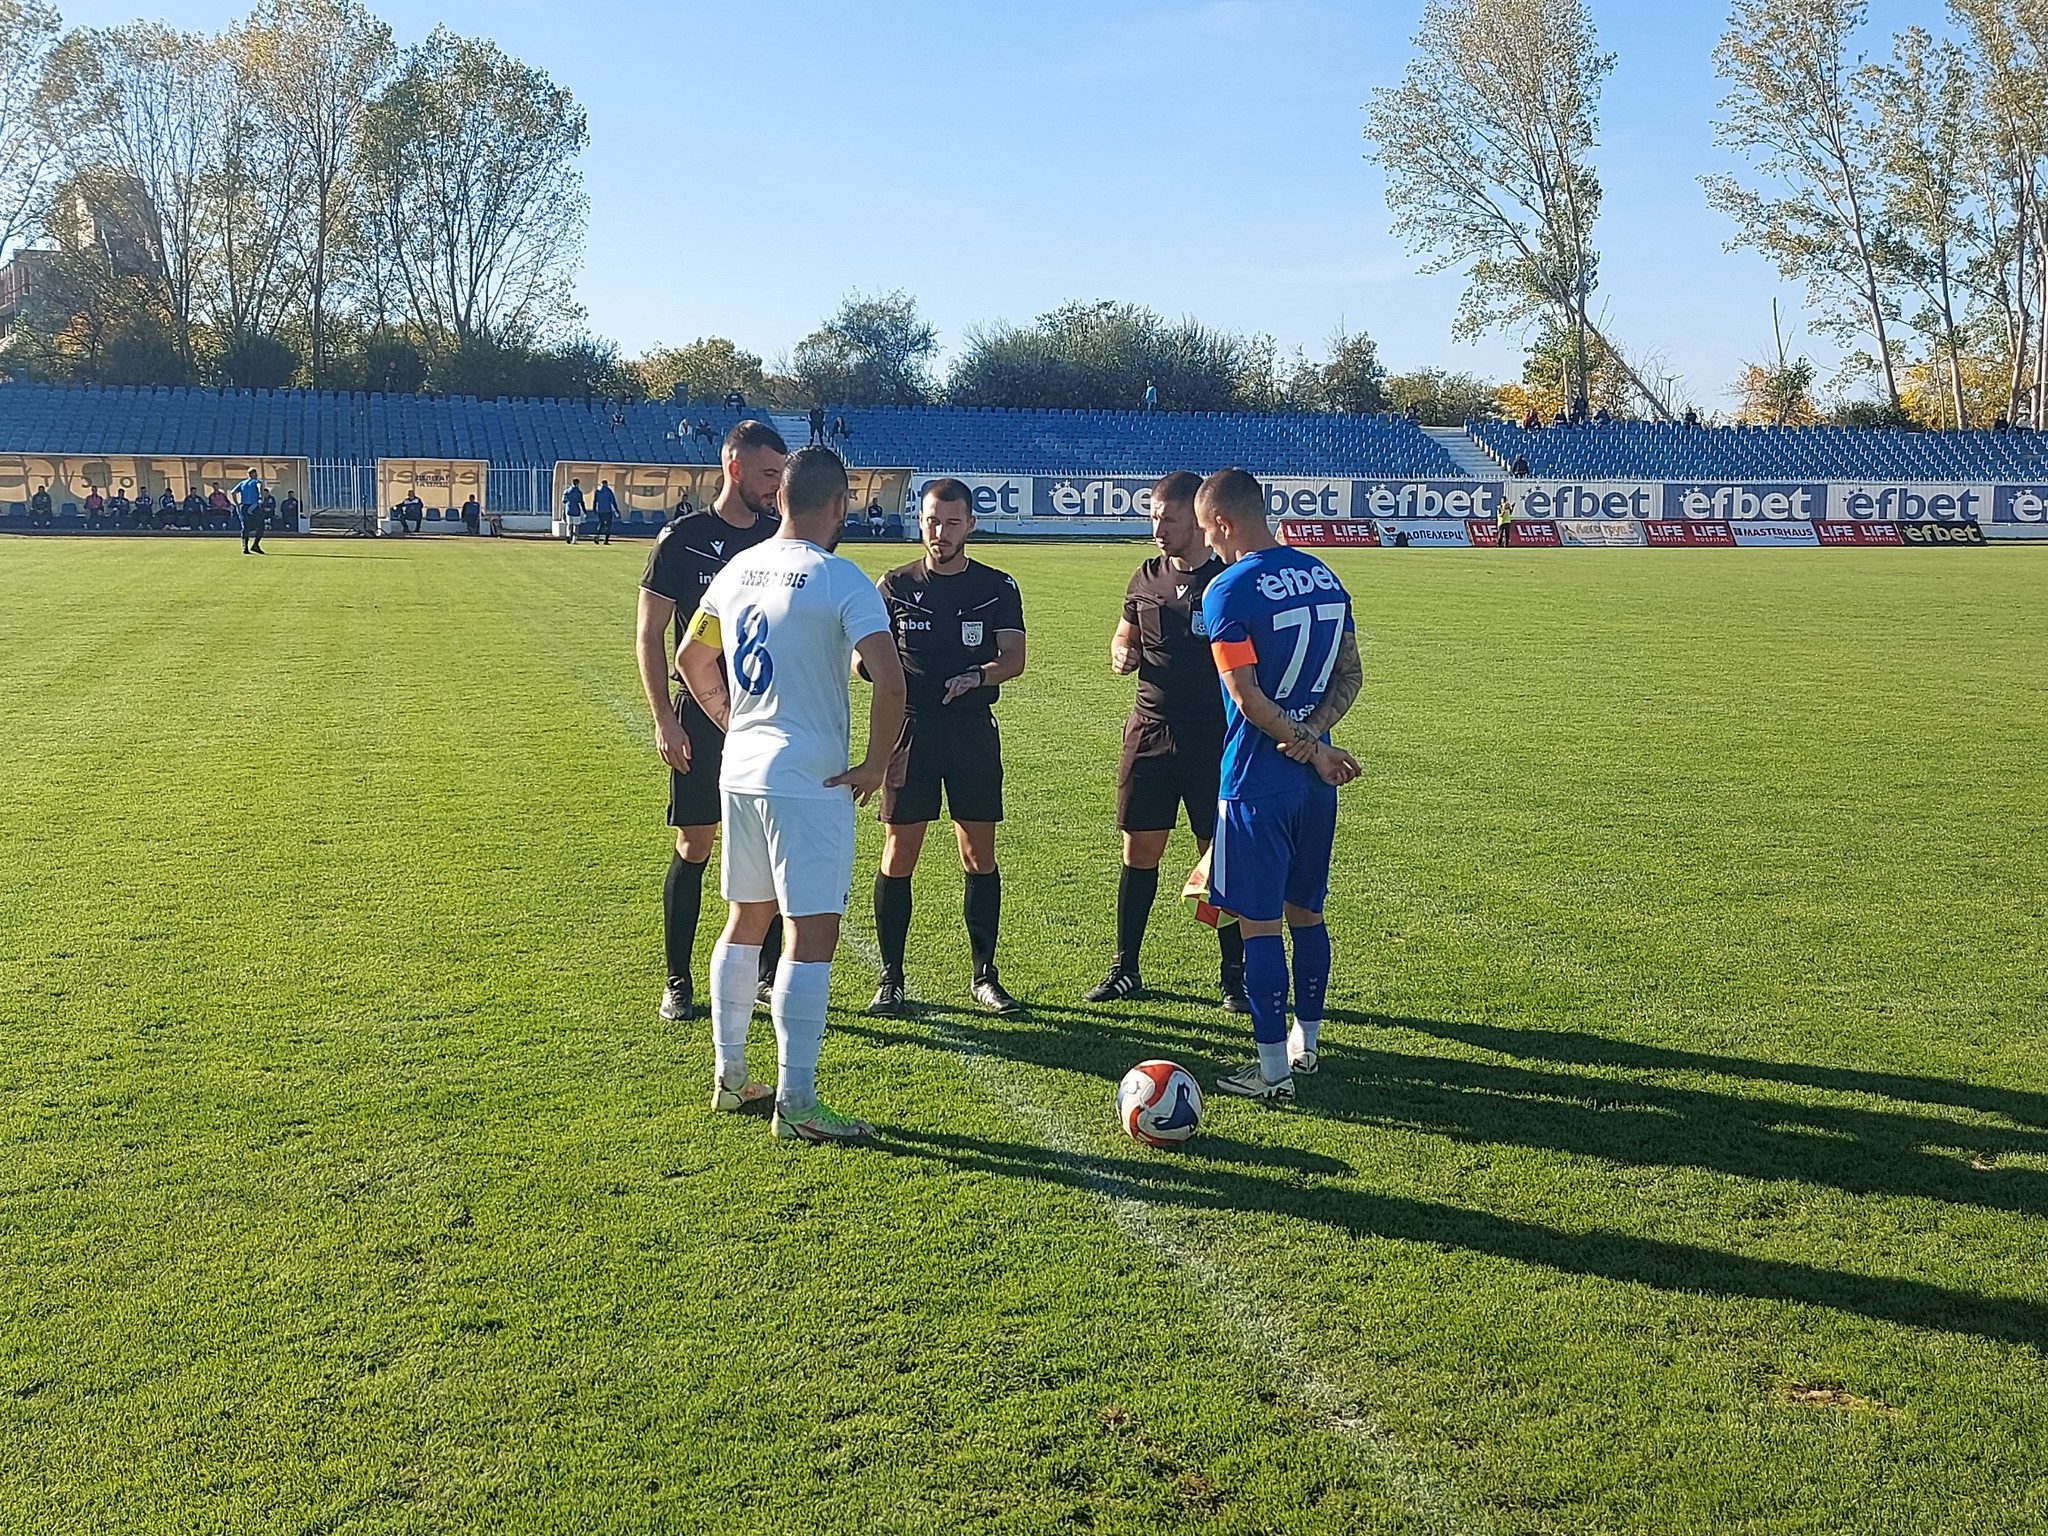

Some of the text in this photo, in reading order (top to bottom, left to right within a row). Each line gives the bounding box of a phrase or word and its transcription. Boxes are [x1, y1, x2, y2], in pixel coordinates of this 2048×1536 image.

[1369, 484, 1492, 517] efbet
[1524, 486, 1650, 518] efbet
[1682, 487, 1811, 520] efbet
[1846, 487, 1980, 520] efbet
[1286, 524, 1325, 537] LIFE
[1332, 524, 1369, 537] LIFE
[1517, 525, 1553, 537] LIFE
[1650, 525, 1684, 537] LIFE
[1692, 525, 1728, 537] LIFE
[1744, 528, 1813, 536] MASTERHAUS
[1818, 525, 1854, 537] LIFE
[1860, 525, 1895, 537] LIFE
[1906, 524, 1980, 542] efbet
[733, 603, 773, 696] 8
[1272, 602, 1346, 700] 77
